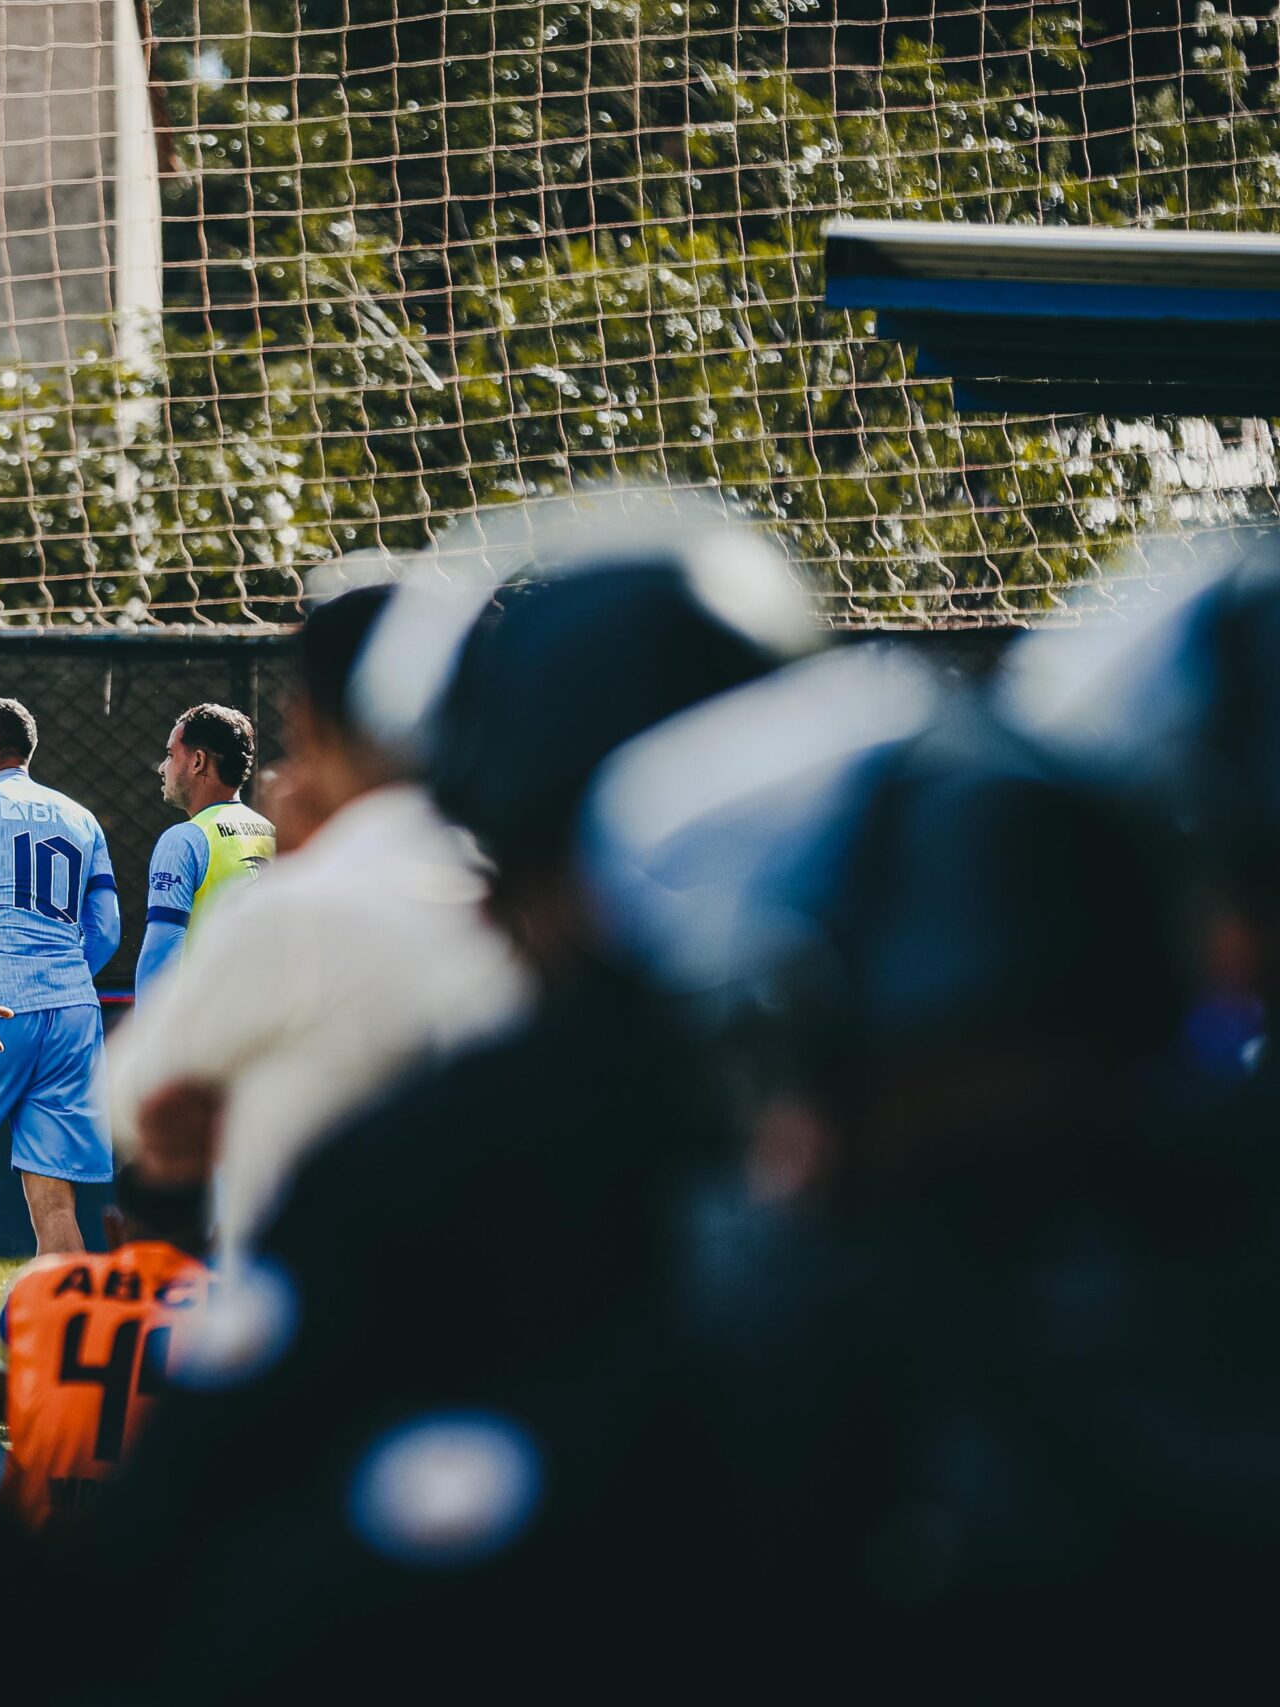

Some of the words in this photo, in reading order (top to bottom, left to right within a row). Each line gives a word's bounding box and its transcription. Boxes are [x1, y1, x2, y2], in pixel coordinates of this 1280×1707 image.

[216, 823, 241, 837] REAL
[13, 830, 84, 925] 10
[55, 1265, 196, 1309] ABC
